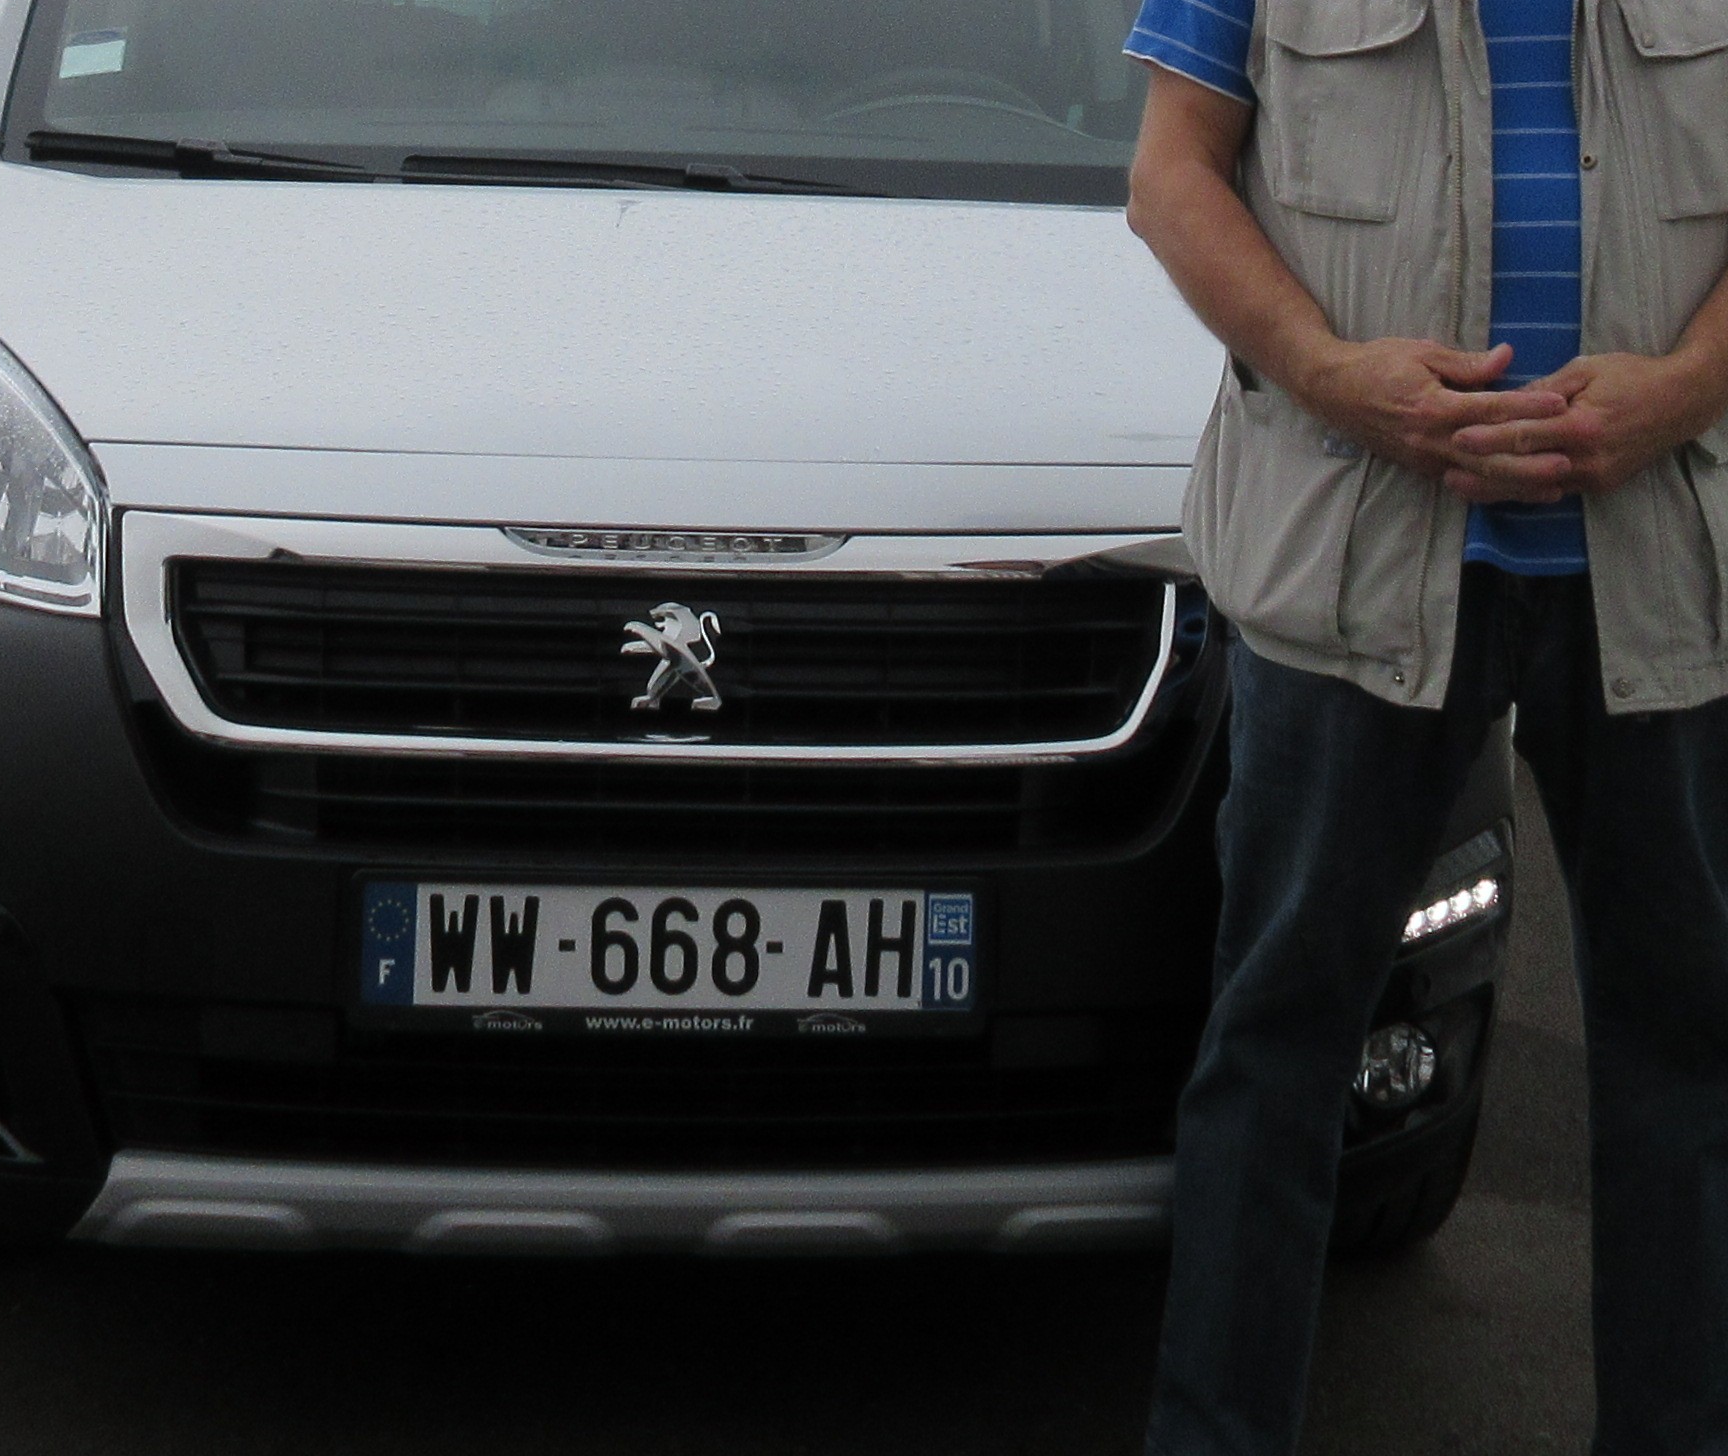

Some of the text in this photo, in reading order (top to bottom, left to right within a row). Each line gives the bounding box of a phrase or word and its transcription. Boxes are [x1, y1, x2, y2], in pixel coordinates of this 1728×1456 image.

[568, 532, 783, 553] PEUGEOT
[933, 902, 969, 914] Grand
[932, 913, 968, 935] Est
[429, 893, 917, 999] WW-668-AH
[378, 959, 395, 985] F
[929, 957, 970, 1001] 10
[585, 1015, 755, 1031] www.e-motors.fr
